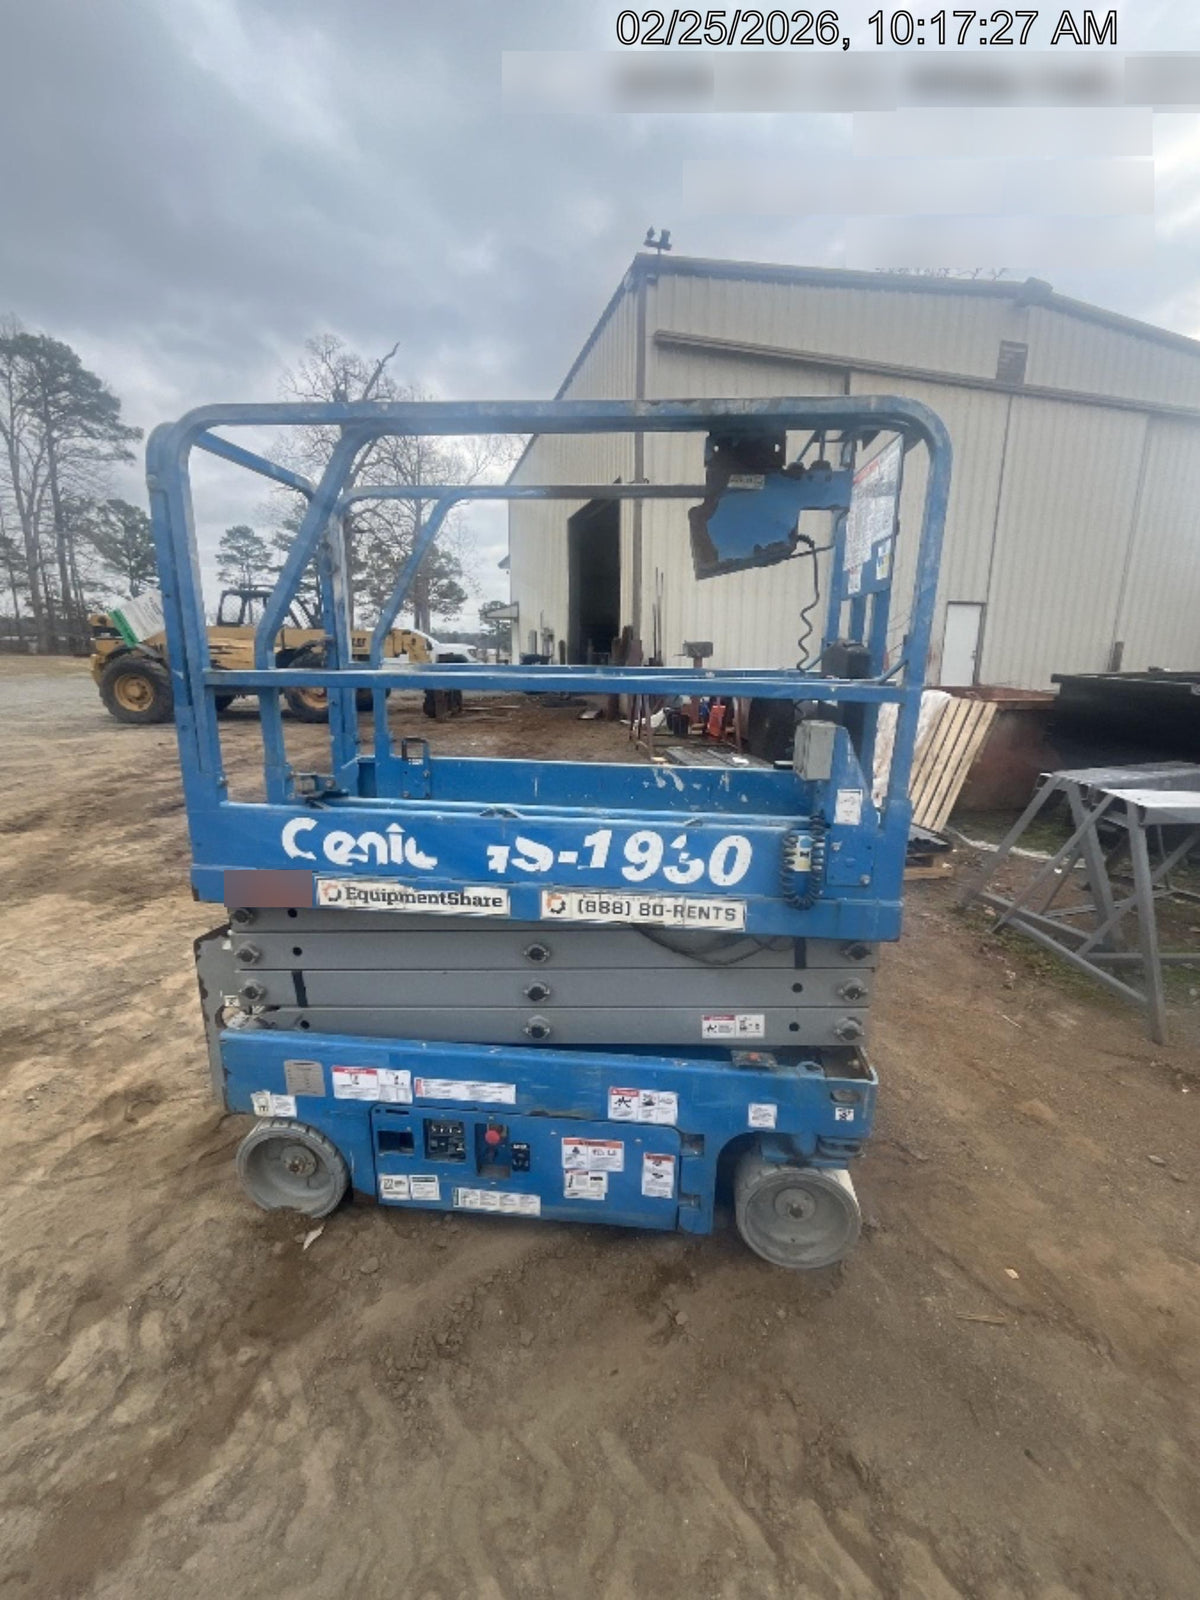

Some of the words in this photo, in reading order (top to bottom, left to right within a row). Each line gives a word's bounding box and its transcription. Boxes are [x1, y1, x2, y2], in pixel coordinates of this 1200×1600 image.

[344, 886, 503, 908] EquipmentShare
[577, 899, 631, 916] (888)
[638, 900, 737, 922] 80-RENTS
